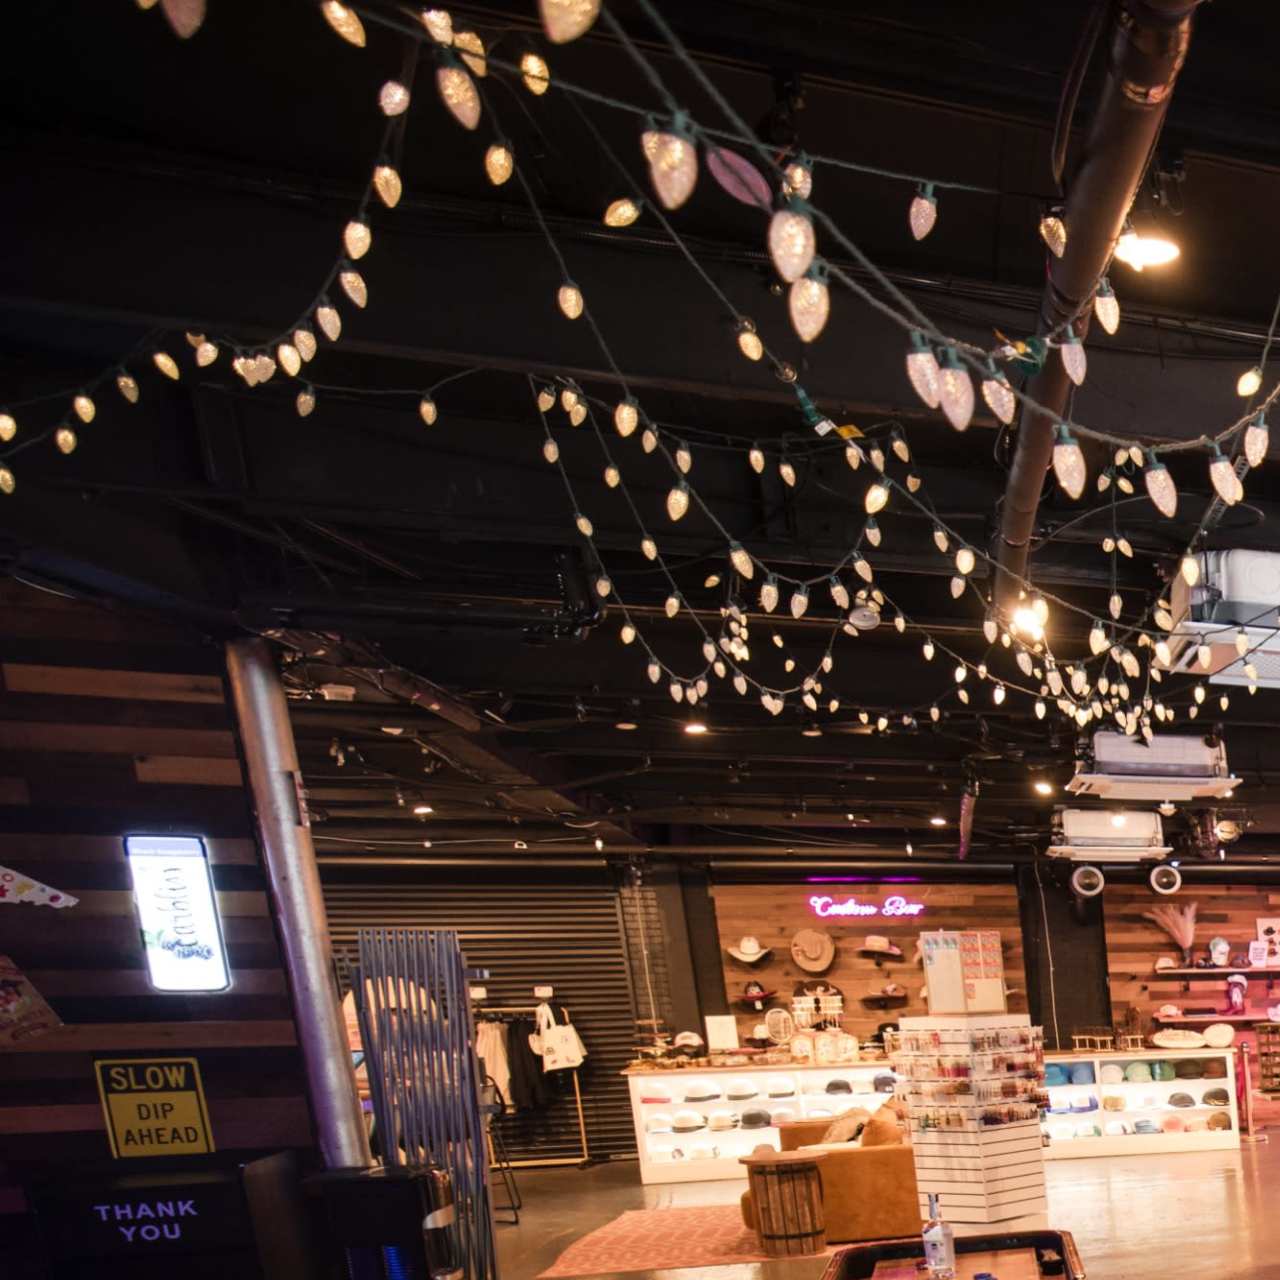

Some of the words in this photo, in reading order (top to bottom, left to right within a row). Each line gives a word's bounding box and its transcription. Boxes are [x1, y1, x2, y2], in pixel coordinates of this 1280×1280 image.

[109, 1065, 186, 1090] SLOW
[137, 1102, 174, 1121] DIP
[124, 1126, 199, 1146] AHEAD
[94, 1200, 199, 1221] THANK
[119, 1223, 182, 1242] YOU
